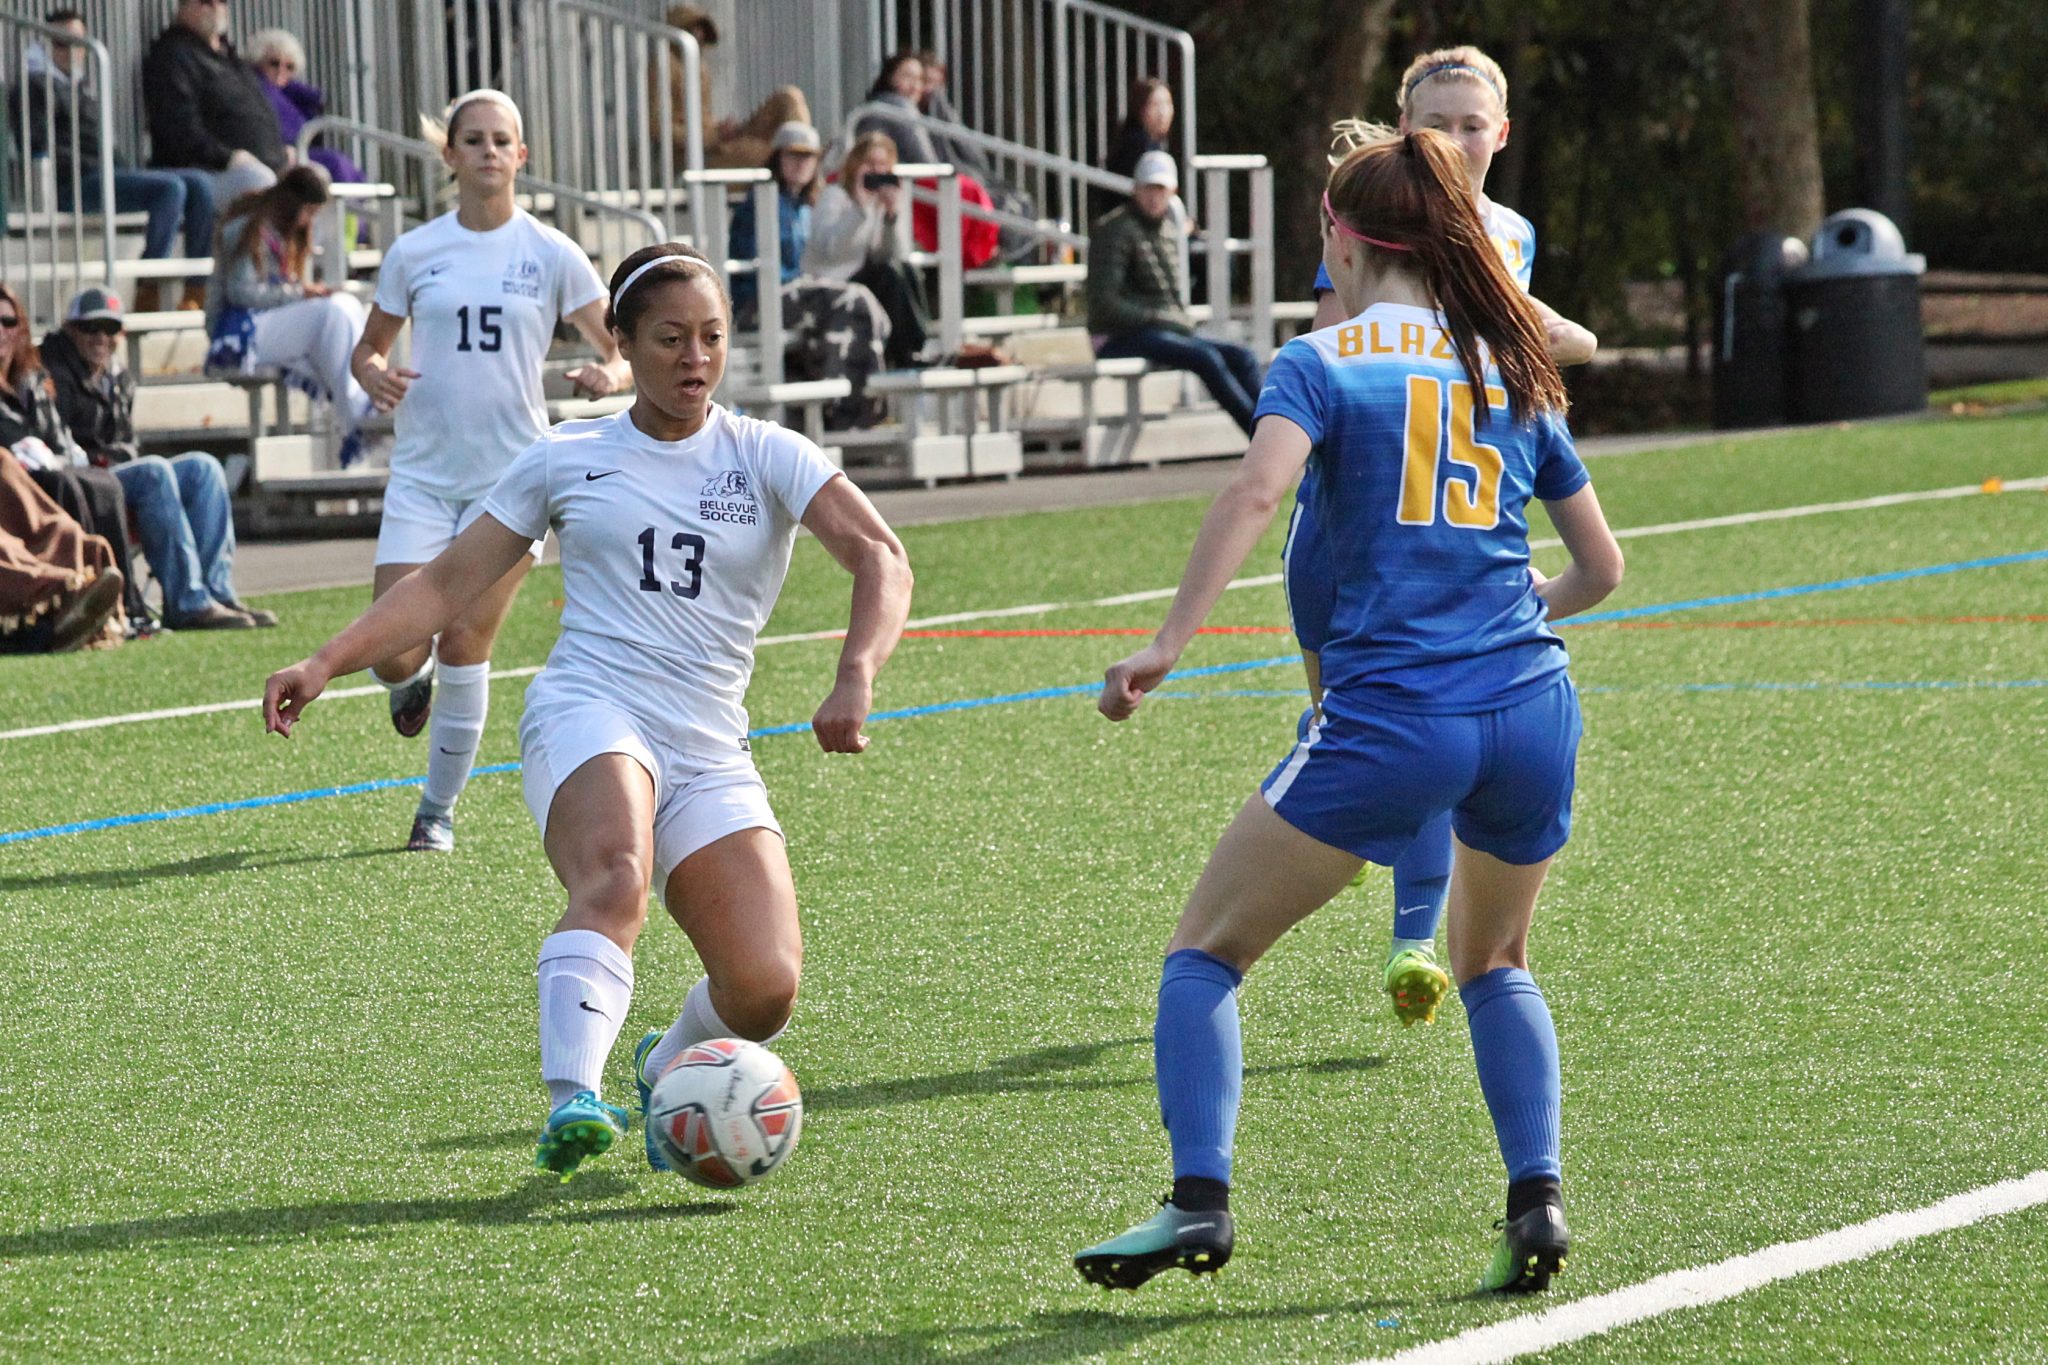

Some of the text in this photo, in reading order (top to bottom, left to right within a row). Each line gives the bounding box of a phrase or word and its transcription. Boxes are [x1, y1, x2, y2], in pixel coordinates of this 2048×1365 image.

[457, 305, 503, 352] 15
[1337, 321, 1498, 366] BLAZ
[1396, 374, 1508, 530] 15
[699, 500, 757, 515] BELLEVUE
[700, 510, 756, 526] SOCCER
[637, 527, 706, 600] 13
